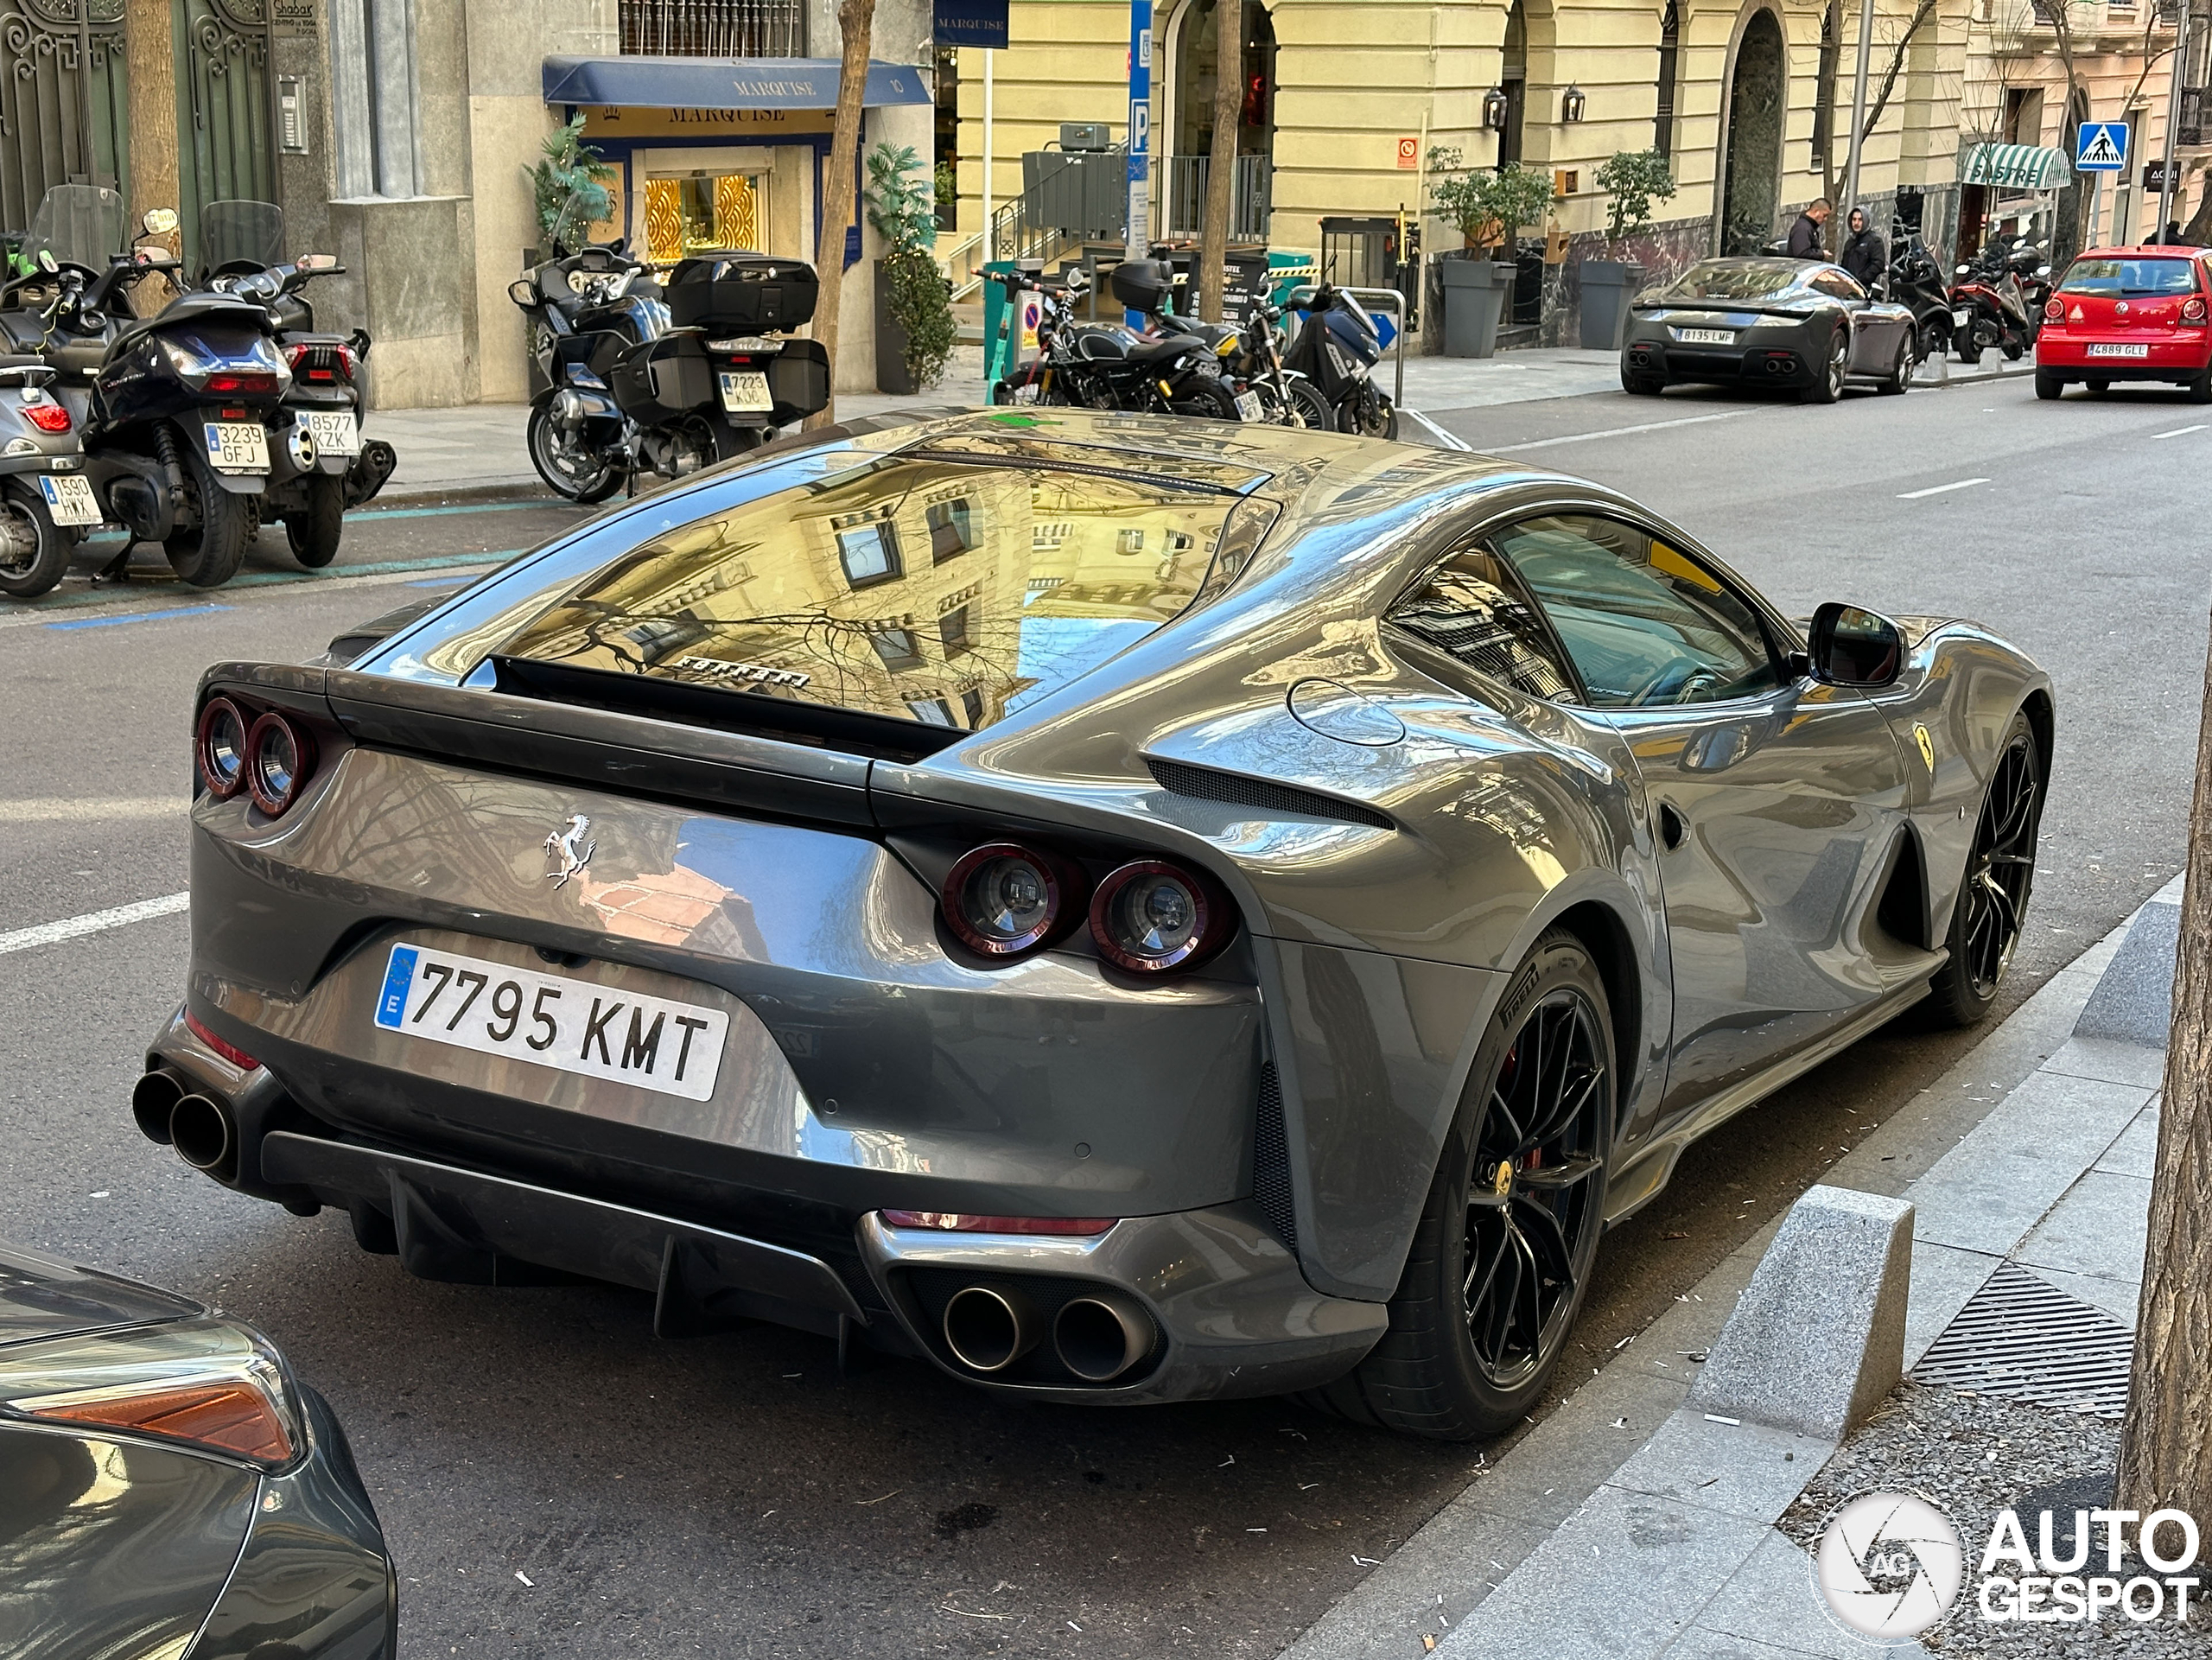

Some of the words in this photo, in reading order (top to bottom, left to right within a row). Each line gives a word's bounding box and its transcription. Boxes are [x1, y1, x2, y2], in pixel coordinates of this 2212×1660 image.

[938, 18, 1004, 31] MARQUISE
[734, 81, 817, 97] MARQUISE
[889, 80, 904, 93] 10
[668, 108, 785, 123] MARQUISE
[1135, 105, 1148, 149] P
[1971, 164, 2038, 183] SASTRE
[1684, 330, 1709, 341] 8135
[1712, 332, 1732, 342] LMF
[2094, 345, 2121, 355] 4889
[2125, 346, 2144, 355] GLL
[731, 375, 764, 389] 7223
[735, 389, 760, 404] KJC
[312, 416, 352, 431] 8577
[219, 427, 262, 444] 3239
[315, 432, 346, 448] KZK
[223, 445, 255, 463] GFJ
[54, 478, 89, 497] 1590
[60, 497, 91, 517] HWX
[672, 655, 810, 687] Ferrari
[385, 994, 400, 1014] E
[1498, 962, 1540, 1031] PIRELLI
[411, 962, 562, 1051] 7795
[580, 997, 709, 1082] KMT
